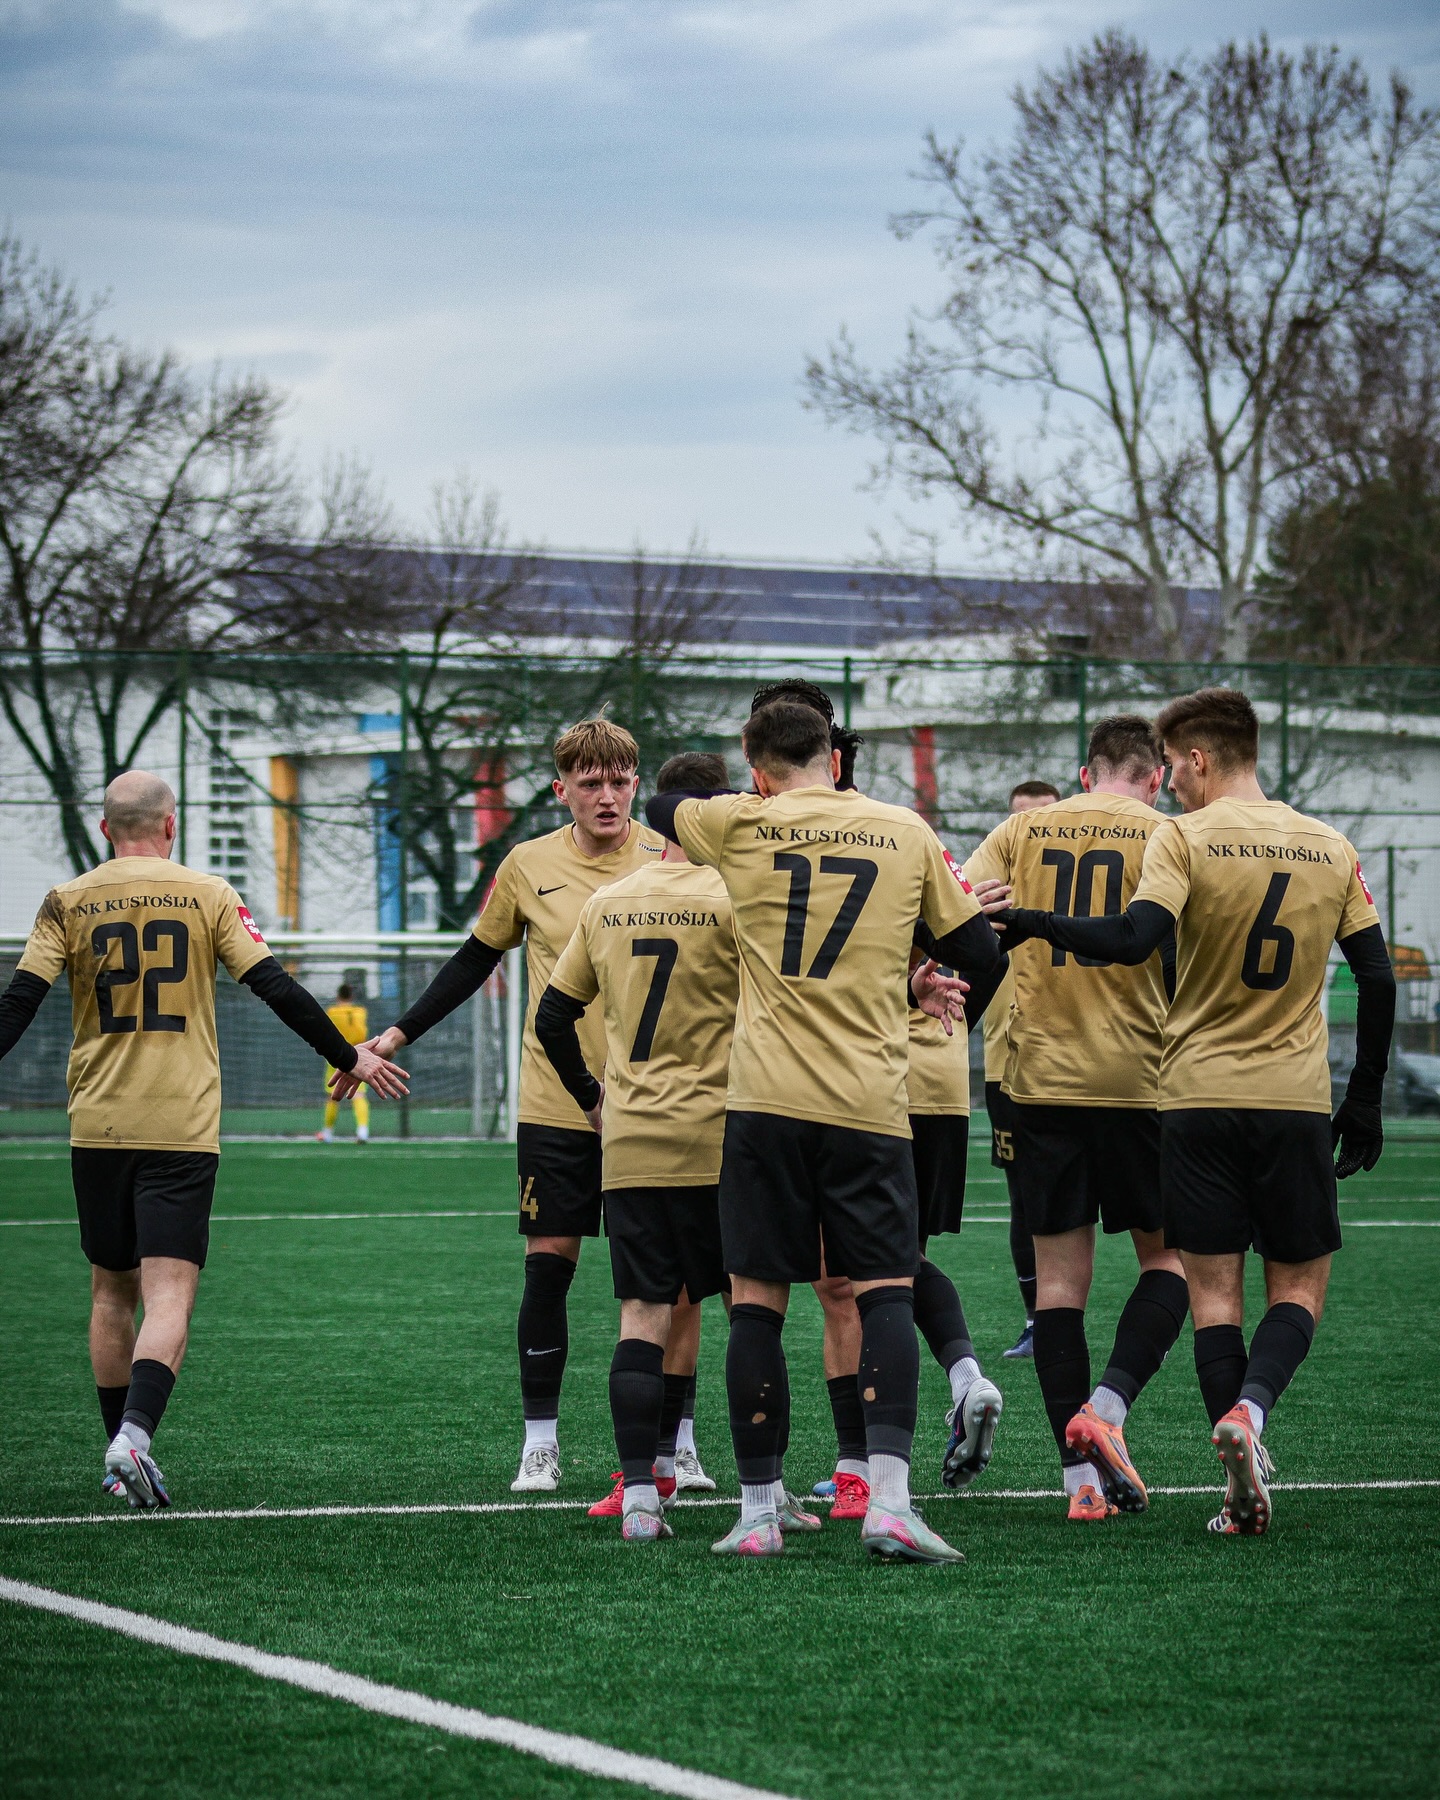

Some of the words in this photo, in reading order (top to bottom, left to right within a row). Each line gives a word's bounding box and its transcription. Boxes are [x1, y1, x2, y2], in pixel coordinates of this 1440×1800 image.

[754, 826, 784, 841] NK
[789, 827, 898, 851] KUSTOŠIJA
[1027, 825, 1053, 840] NK
[1057, 824, 1147, 841] KUSTOŠIJA
[1207, 844, 1235, 858] NK
[1238, 845, 1333, 865] KUSTOŠIJA
[77, 902, 102, 918] NK
[105, 893, 200, 912] KUSTOŠIJA
[601, 914, 623, 929] NK
[626, 909, 720, 927] KUSTOŠIJA
[773, 852, 879, 980] 17
[1041, 848, 1124, 968] 10
[1241, 872, 1295, 991] 6
[91, 920, 189, 1034] 22
[629, 938, 679, 1063] 7
